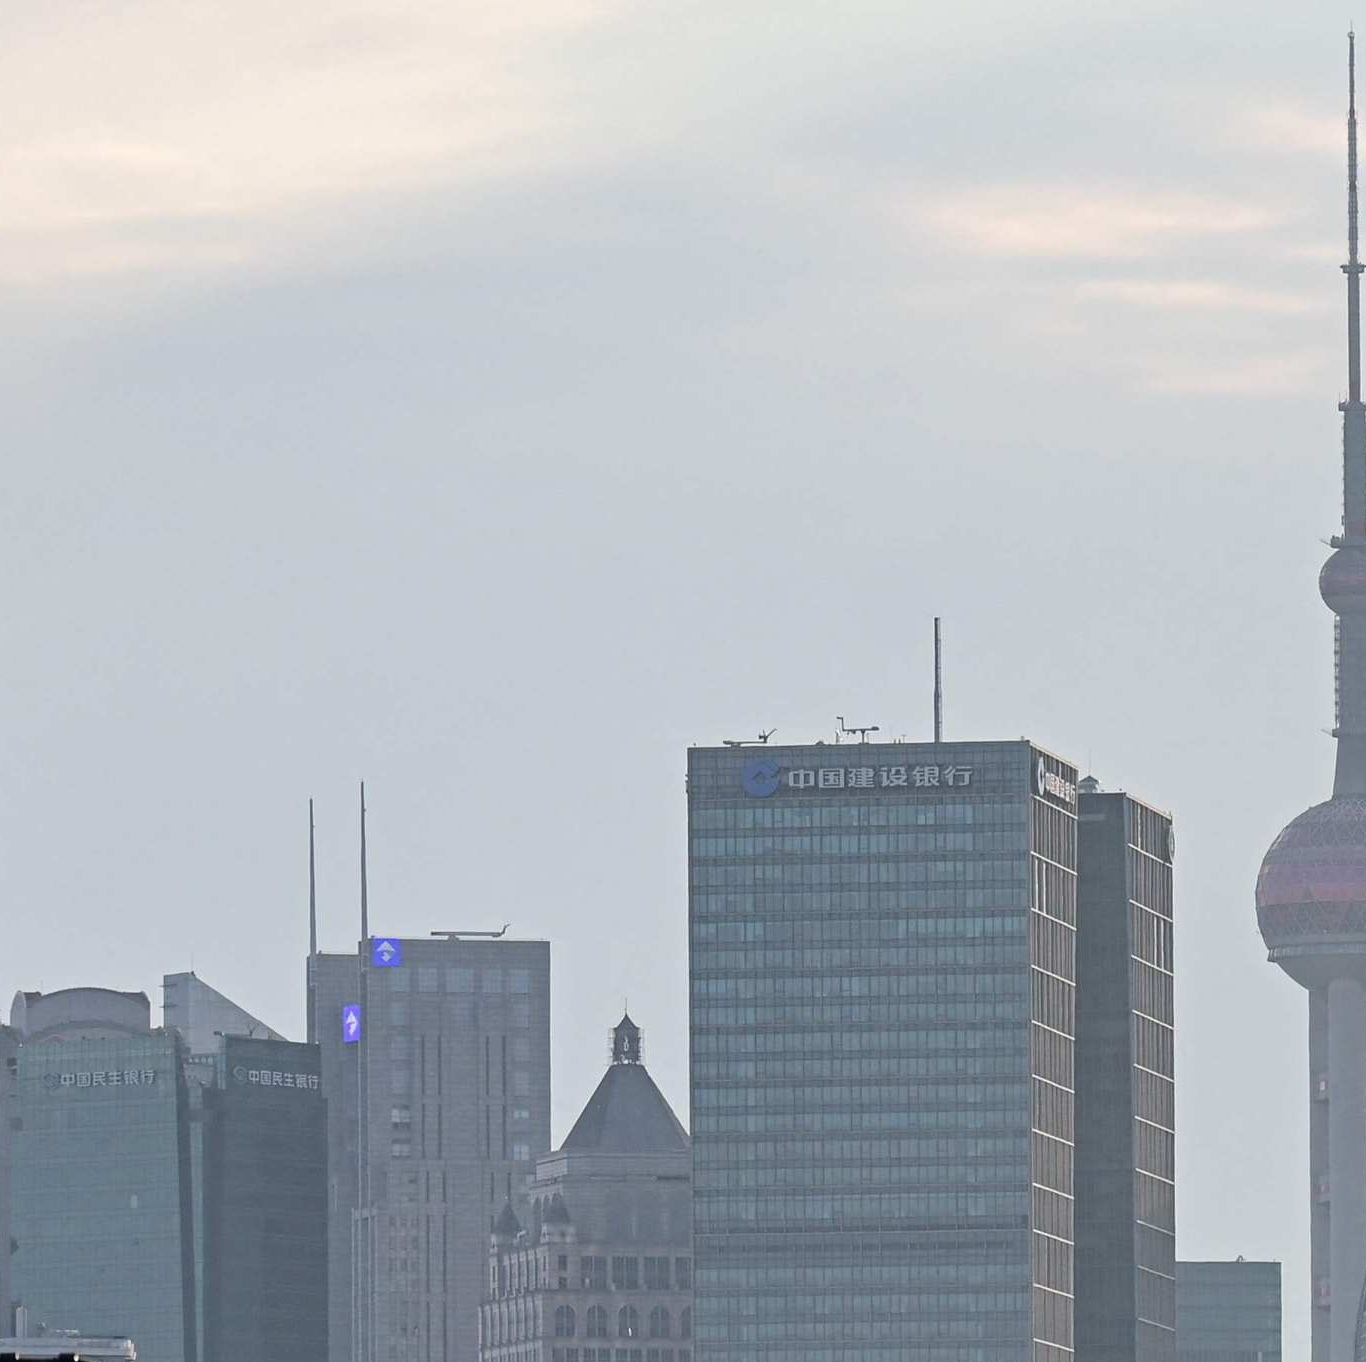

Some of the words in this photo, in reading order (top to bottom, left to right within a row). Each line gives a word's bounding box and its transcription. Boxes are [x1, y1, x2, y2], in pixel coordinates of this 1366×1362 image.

[788, 766, 972, 789] 中国建设银行
[60, 1070, 155, 1088] 中国民生银行
[248, 1069, 319, 1090] 中国民生银行
